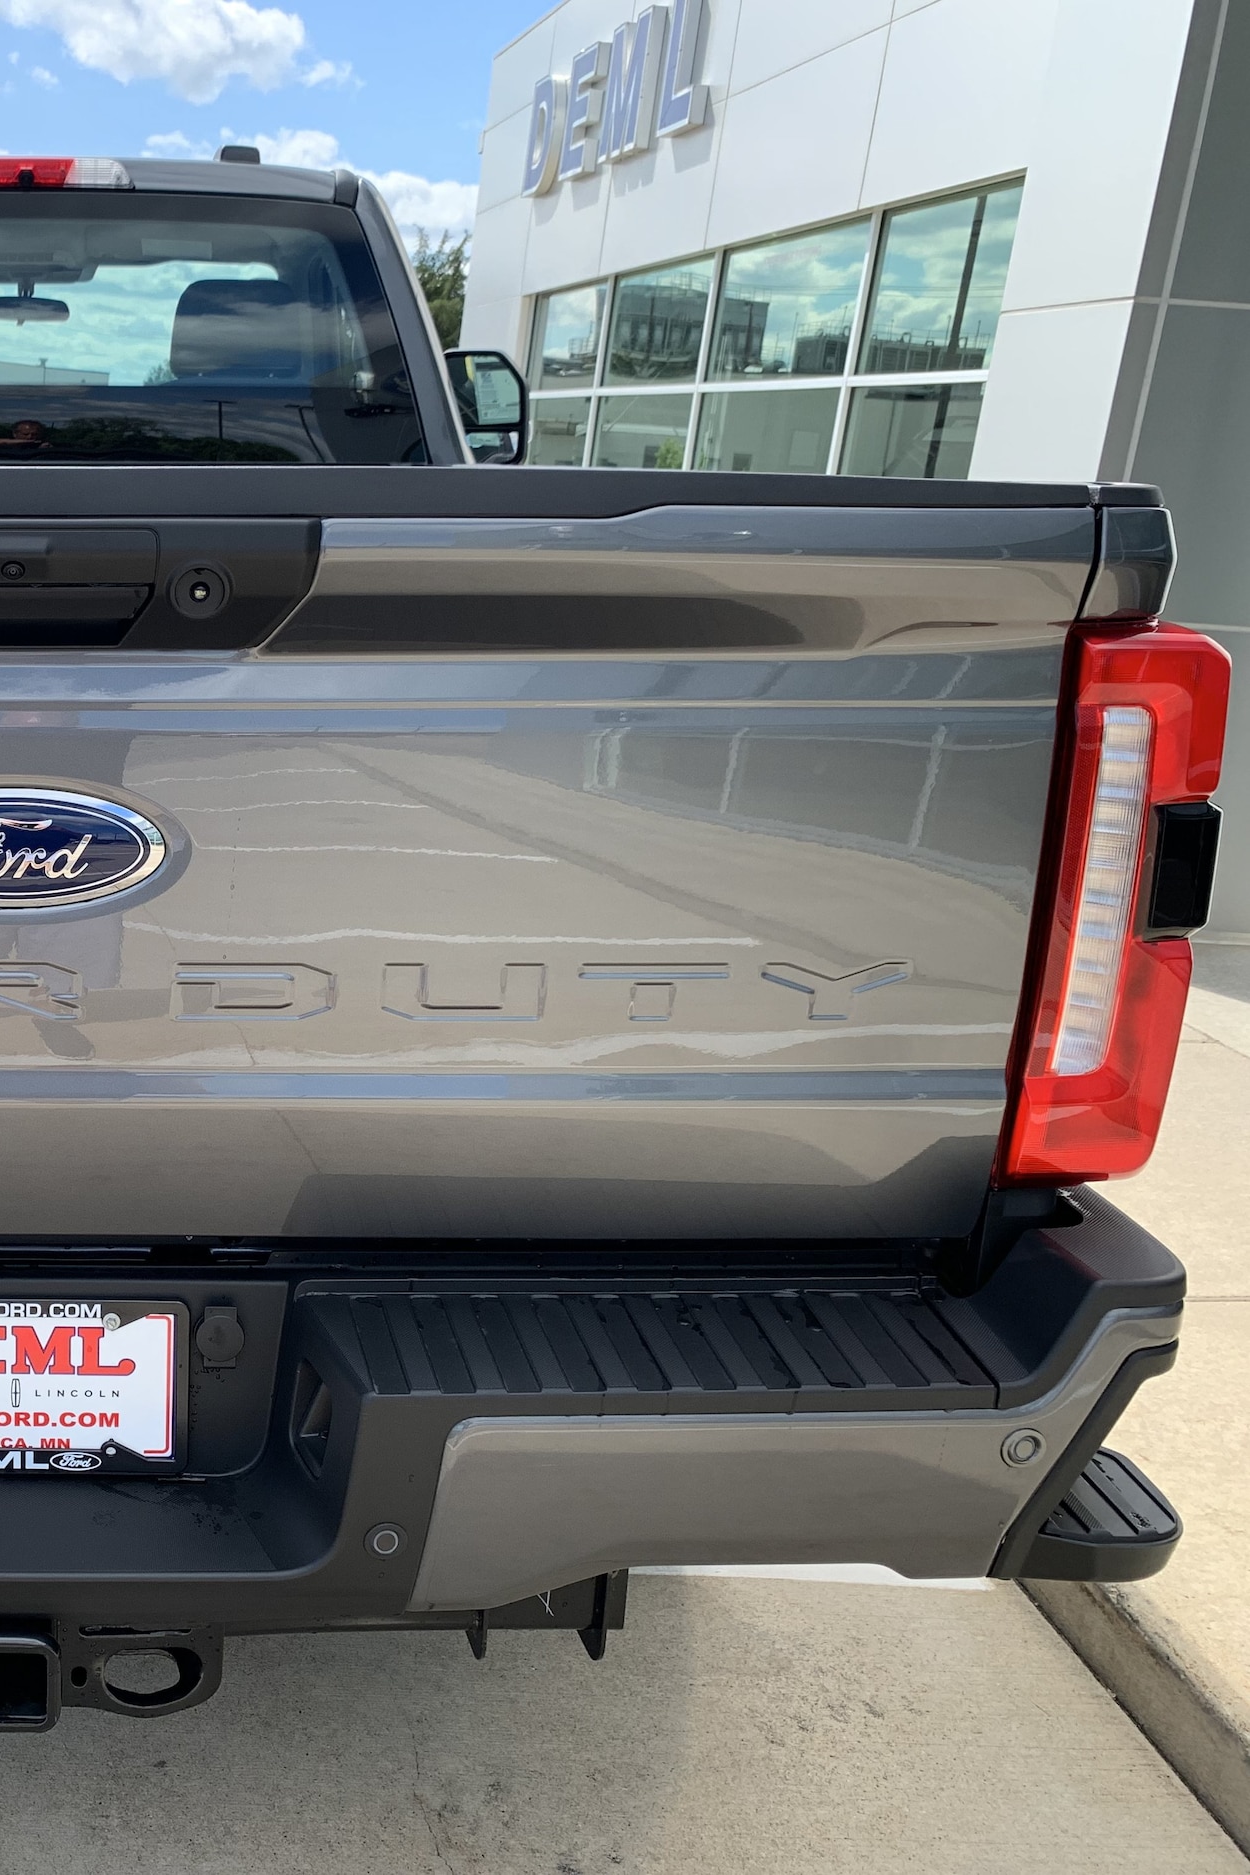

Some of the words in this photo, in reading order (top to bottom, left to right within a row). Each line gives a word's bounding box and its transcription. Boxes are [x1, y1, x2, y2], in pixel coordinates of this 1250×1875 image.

[521, 0, 709, 198] DEML
[169, 960, 911, 1022] DUTY
[35, 1389, 120, 1398] LINCOLN
[40, 1438, 71, 1449] MN
